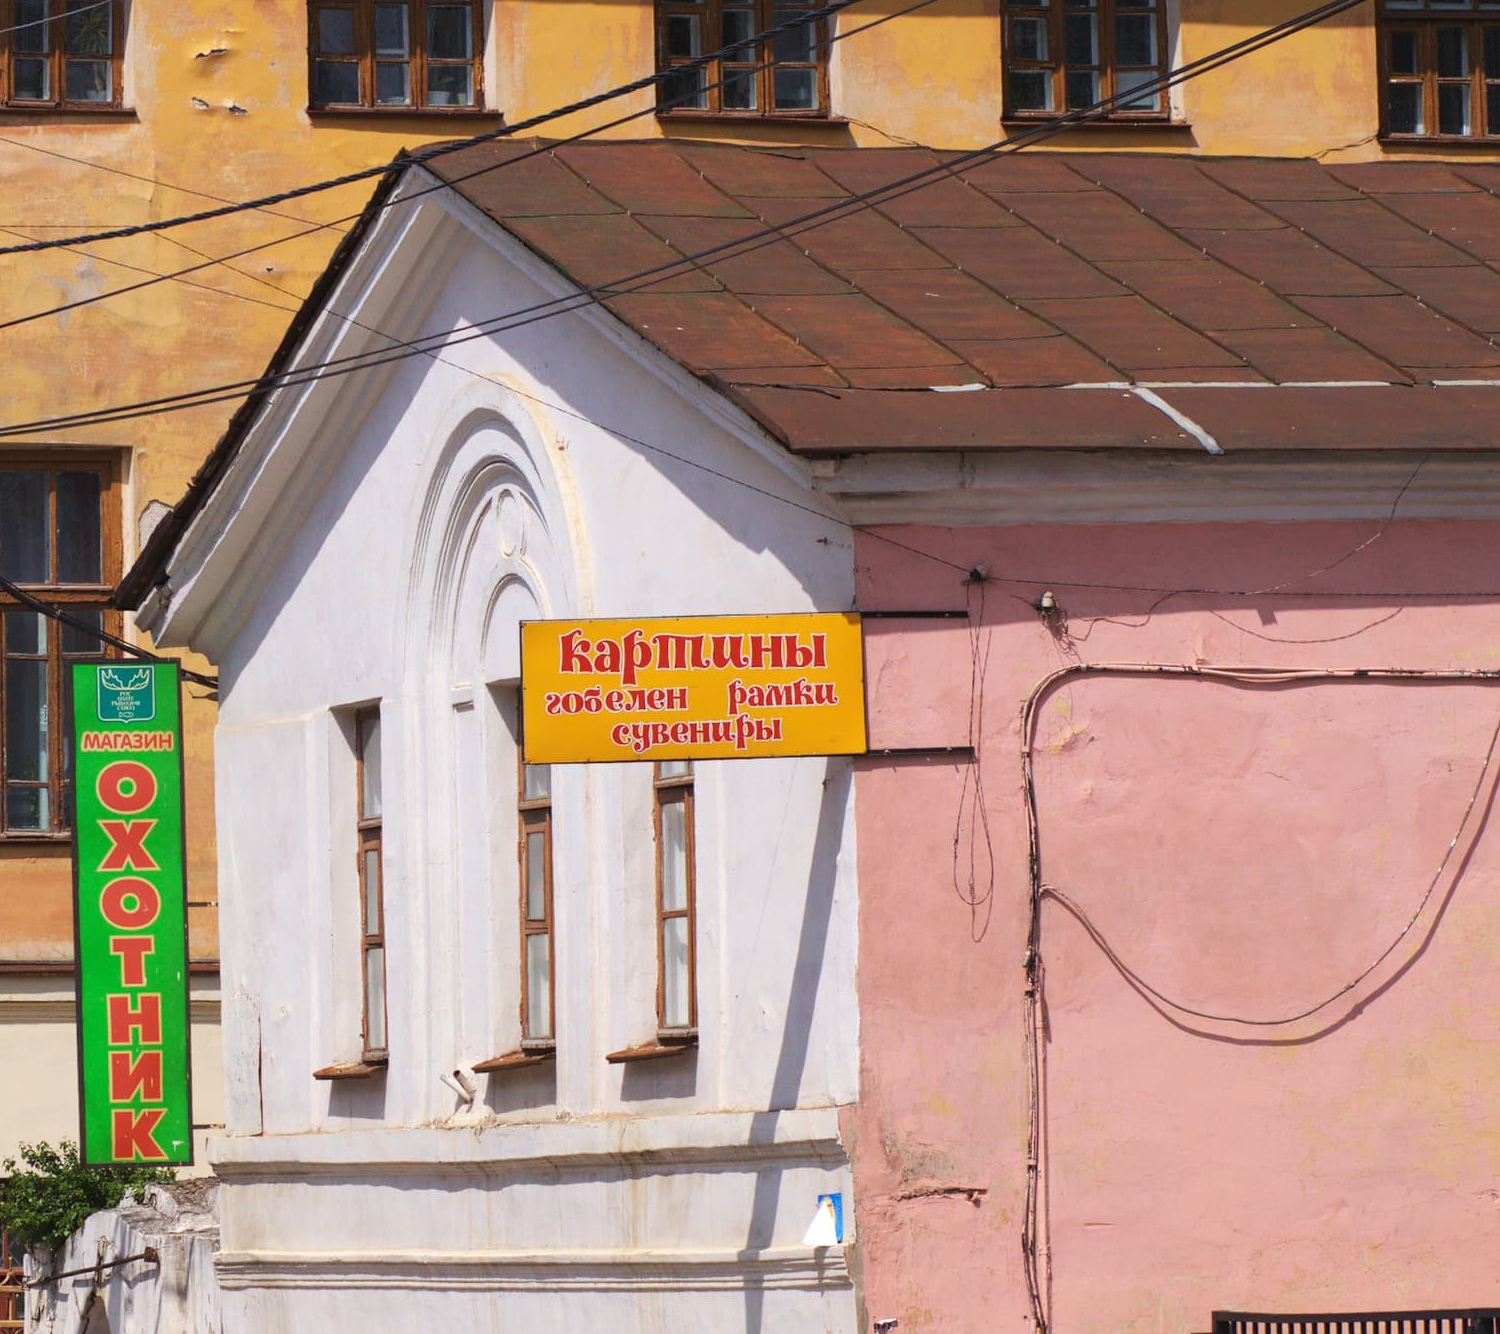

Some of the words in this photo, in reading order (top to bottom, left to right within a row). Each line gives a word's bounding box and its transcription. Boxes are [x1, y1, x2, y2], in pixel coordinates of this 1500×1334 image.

[545, 685, 689, 716] гобелен
[727, 678, 838, 716] рамки
[83, 732, 173, 750] МАГАЗИН
[611, 714, 782, 754] сувениры
[95, 760, 169, 1161] ОХОТНИК
